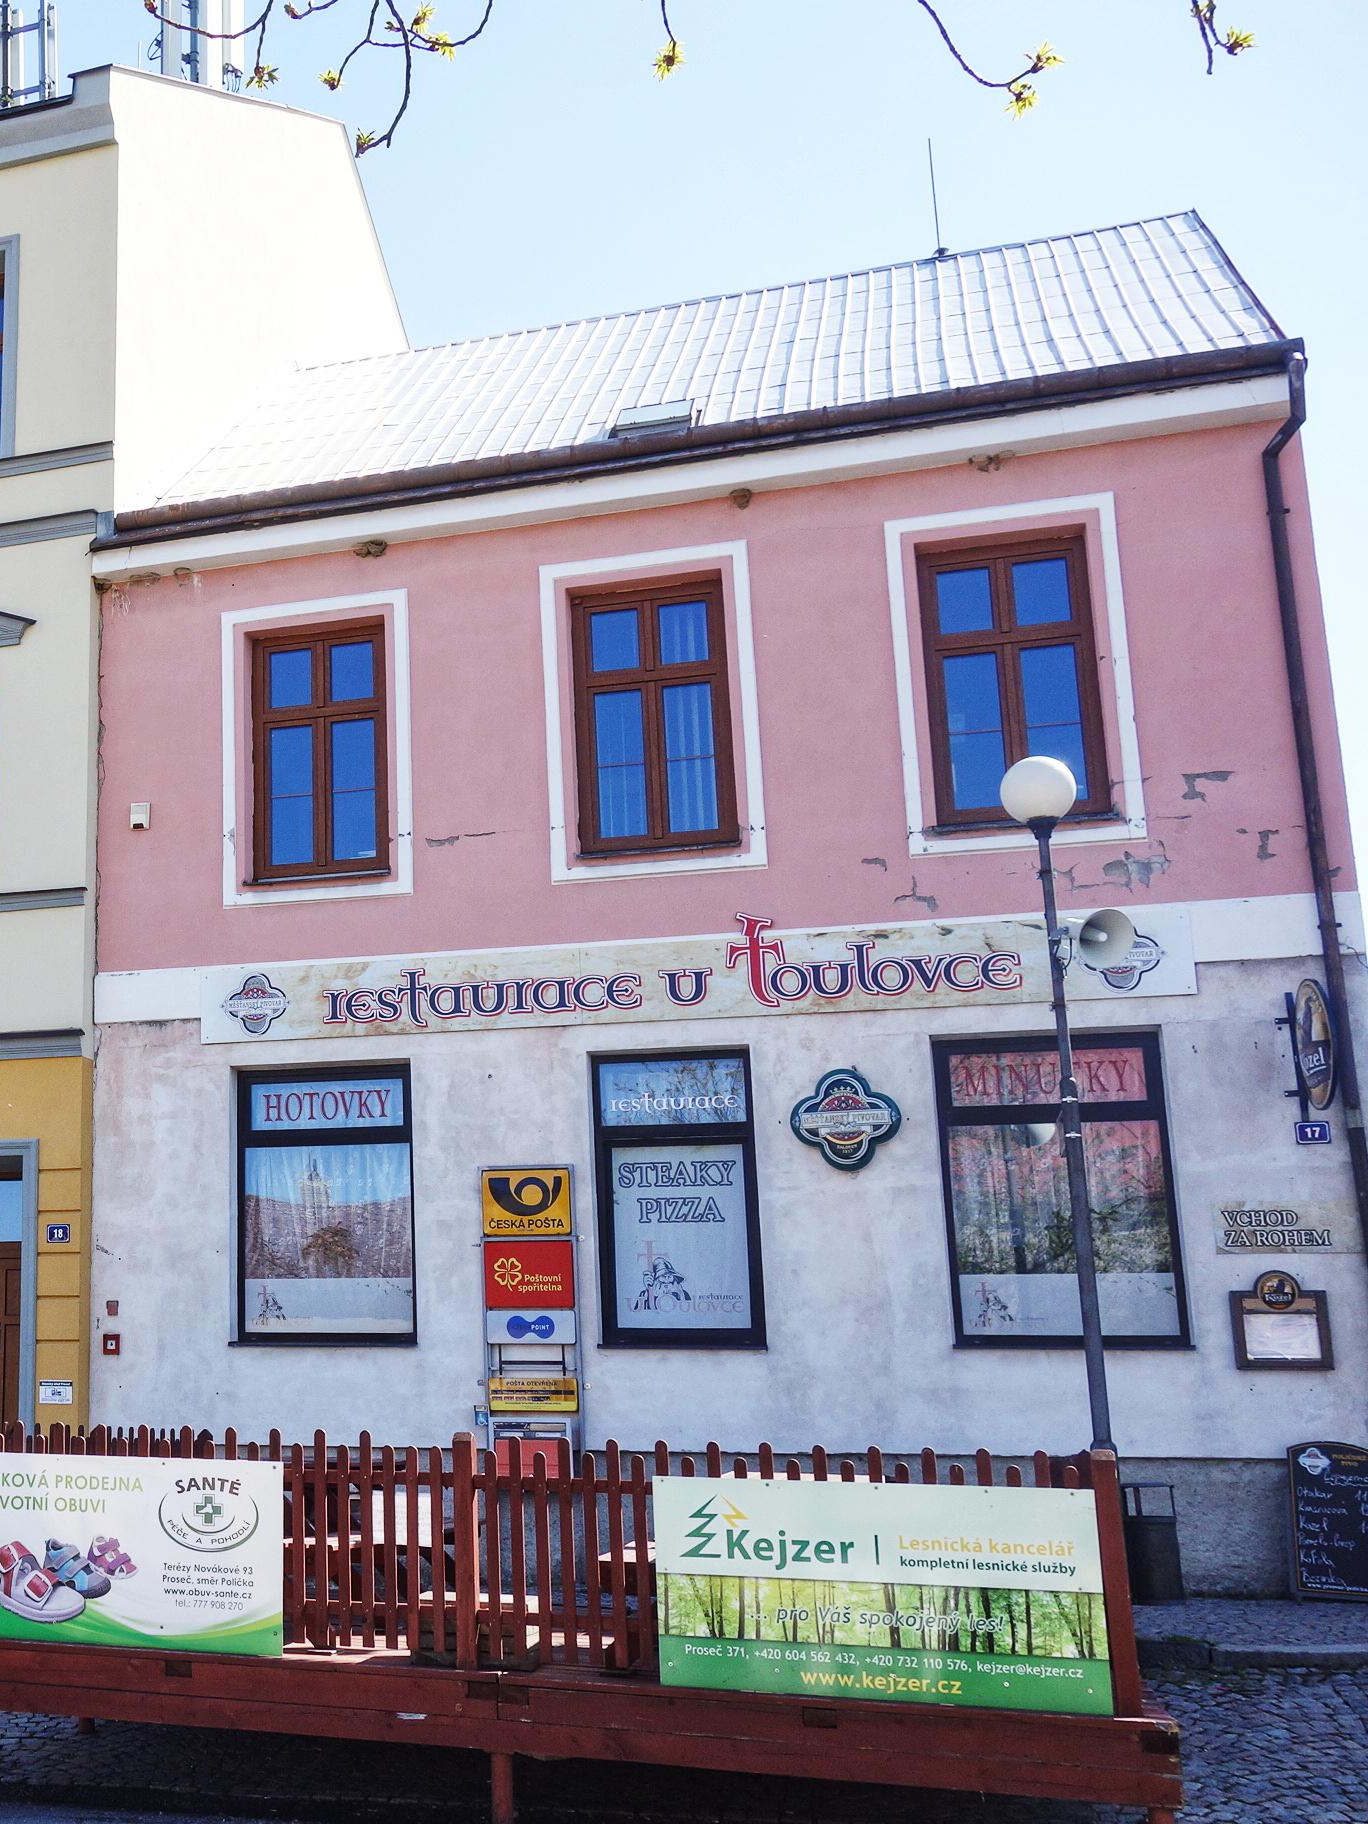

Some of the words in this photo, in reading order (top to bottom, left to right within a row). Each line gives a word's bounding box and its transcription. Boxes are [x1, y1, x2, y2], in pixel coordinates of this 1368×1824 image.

[323, 968, 642, 1028] restaurace
[658, 967, 714, 1007] u
[726, 912, 1023, 1008] Toulovce
[263, 1089, 391, 1122] HOTOVKY
[610, 1092, 739, 1113] restaurace
[1305, 1127, 1321, 1139] 17
[618, 1160, 736, 1188] STEAKY
[637, 1197, 725, 1223] PIZZA
[1221, 1210, 1299, 1227] VCHOD
[488, 1217, 526, 1229] ČESKÁ
[527, 1217, 564, 1229] POŠTA
[53, 1228, 63, 1238] 18
[1224, 1230, 1253, 1247] ZA
[1255, 1229, 1332, 1247] ROHEM
[524, 1273, 562, 1283] Poštovní
[517, 1283, 563, 1293] spořitelna
[55, 1473, 144, 1492] PRODEJNA
[175, 1477, 242, 1496] SANTÉ
[54, 1497, 106, 1513] OBUVI
[167, 1519, 189, 1540] PÉČE
[211, 1520, 251, 1545] POHODLÍ
[726, 1529, 855, 1571] Kejzer
[899, 1535, 983, 1553] Lesnická
[989, 1538, 1075, 1556] kancelář
[163, 1562, 192, 1573] Terézy
[194, 1564, 240, 1575] Novákové
[243, 1566, 253, 1575] 93
[900, 1556, 969, 1571] kompletní
[973, 1559, 1028, 1572] lesnické
[1031, 1561, 1076, 1577] služby
[162, 1574, 194, 1585] Proseč,
[196, 1576, 219, 1586] směr
[221, 1577, 254, 1587] Polička
[163, 1588, 252, 1599] www.obuv-sante.cz
[193, 1600, 208, 1608] 777
[210, 1600, 226, 1610] 908
[228, 1601, 244, 1611] 270
[776, 1607, 809, 1623] pro
[819, 1606, 852, 1624] Váš
[859, 1609, 960, 1632] spokojený
[969, 1613, 1005, 1632] les!
[685, 1644, 723, 1657] Proseč
[727, 1646, 750, 1660] 371,
[754, 1648, 781, 1660] +420
[785, 1649, 807, 1661] 604
[810, 1651, 831, 1663] 562
[835, 1652, 860, 1666] 432,
[865, 1655, 893, 1667] +420
[898, 1656, 919, 1668] 732
[923, 1658, 943, 1670] 110
[947, 1659, 972, 1673] 576,
[976, 1661, 1084, 1678] kejzer@kejzer.cz
[800, 1671, 963, 1695] www.kejzer.cz
